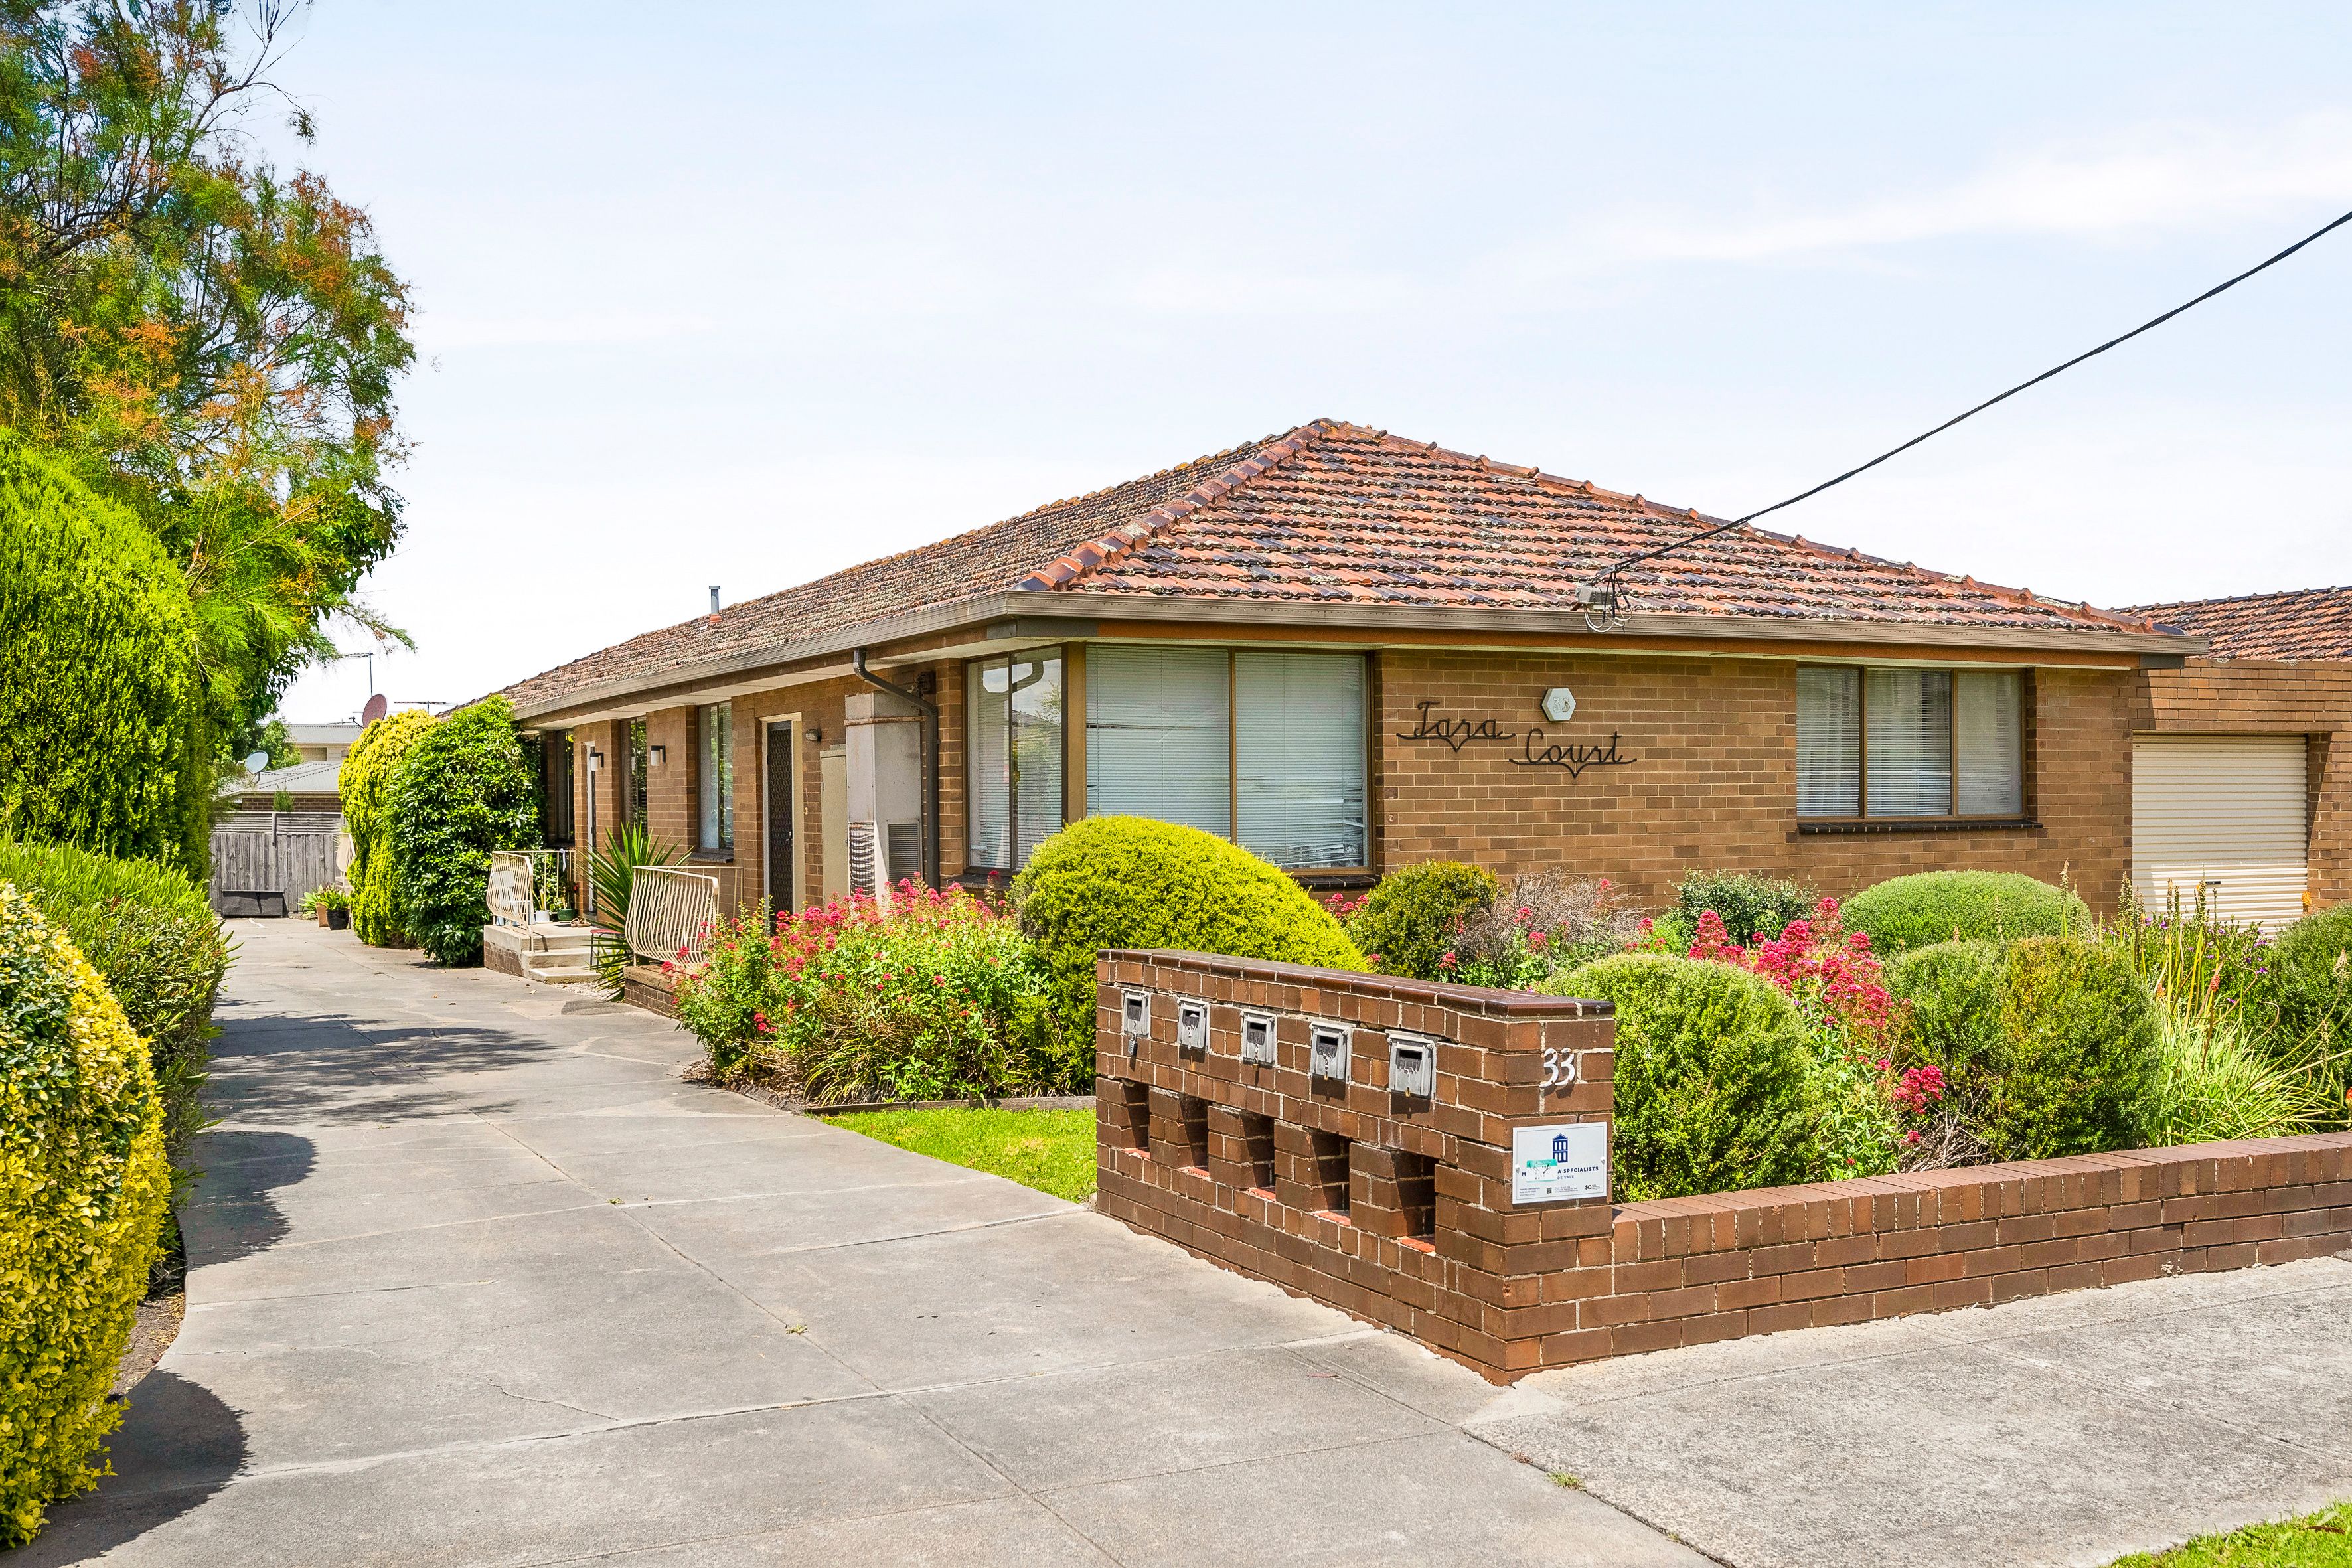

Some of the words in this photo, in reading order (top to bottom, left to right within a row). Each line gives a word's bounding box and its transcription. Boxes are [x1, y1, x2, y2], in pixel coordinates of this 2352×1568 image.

[1413, 701, 1504, 738] Tara
[1526, 728, 1624, 764] Court
[1539, 1047, 1576, 1087] 33
